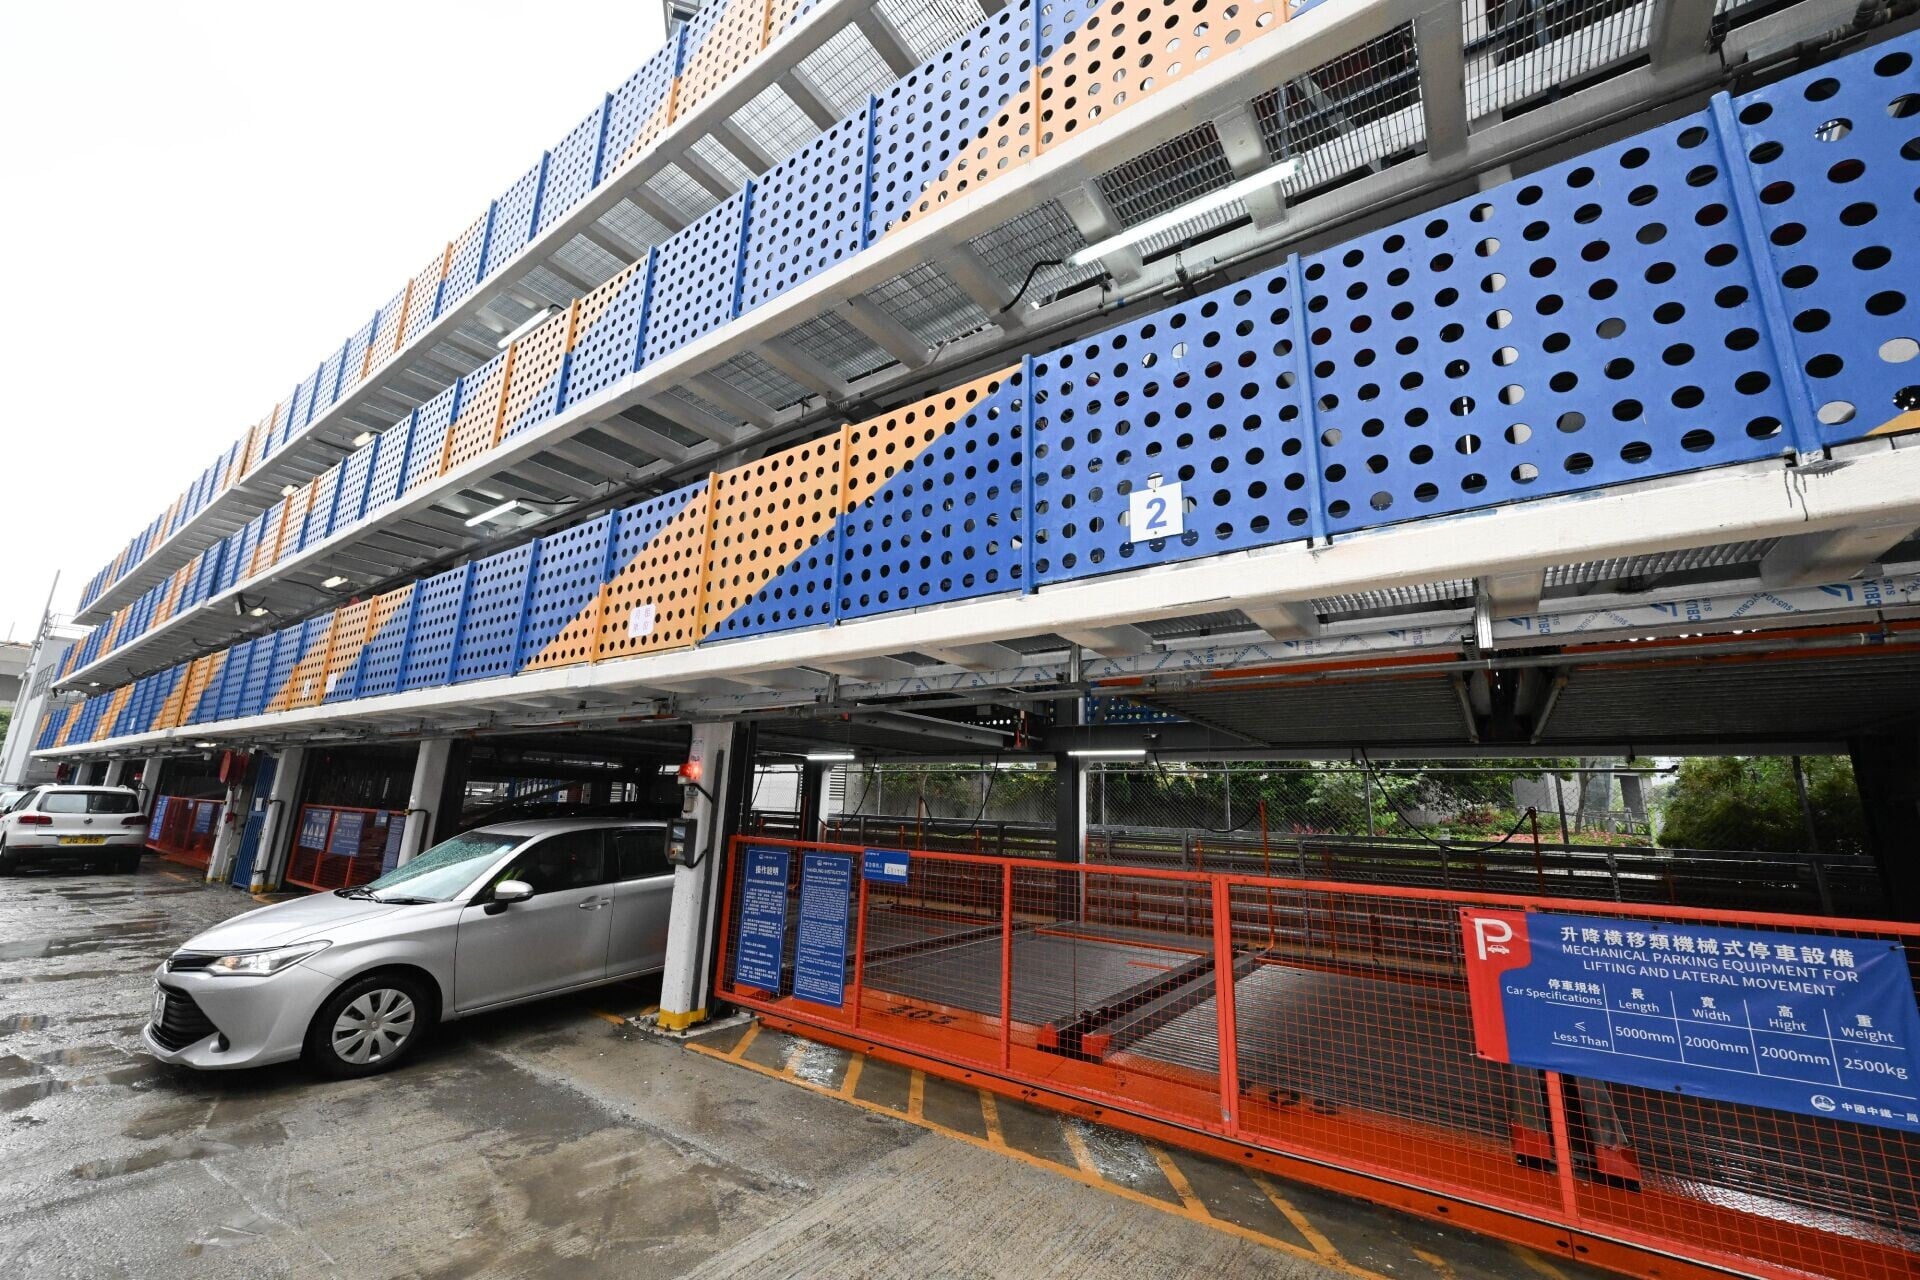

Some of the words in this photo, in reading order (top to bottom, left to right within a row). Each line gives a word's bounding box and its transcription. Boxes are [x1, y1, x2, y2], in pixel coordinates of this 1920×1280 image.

[1146, 497, 1167, 530] 2
[1474, 917, 1513, 961] P
[1562, 945, 1650, 962] MECHANICAL
[1653, 953, 1718, 969] PARKING
[1722, 959, 1818, 979] EQUIPMENT
[1823, 969, 1859, 983] FOR
[1548, 978, 1601, 995] 停車規格
[1583, 961, 1636, 975] LIFTING
[1639, 967, 1669, 979] AND
[1673, 970, 1738, 987] LATERAL
[1742, 976, 1836, 997] MOVEMENT
[1506, 985, 1524, 996] Car
[1526, 988, 1603, 1006] Specifications
[1630, 988, 1645, 1001] 長
[1618, 1000, 1660, 1014] Length
[1692, 1008, 1731, 1023] Width
[1777, 1005, 1793, 1019] 高
[1769, 1018, 1807, 1033] Hight
[1855, 1014, 1873, 1028] 重
[1553, 1031, 1578, 1044] Less
[1580, 1035, 1609, 1048] Than
[1615, 1026, 1675, 1044] 5000mm
[1840, 1027, 1895, 1044] Weight
[1684, 1035, 1749, 1055] 2000mm
[1759, 1046, 1831, 1066] 2000mm
[1843, 1057, 1909, 1080] 2500kg
